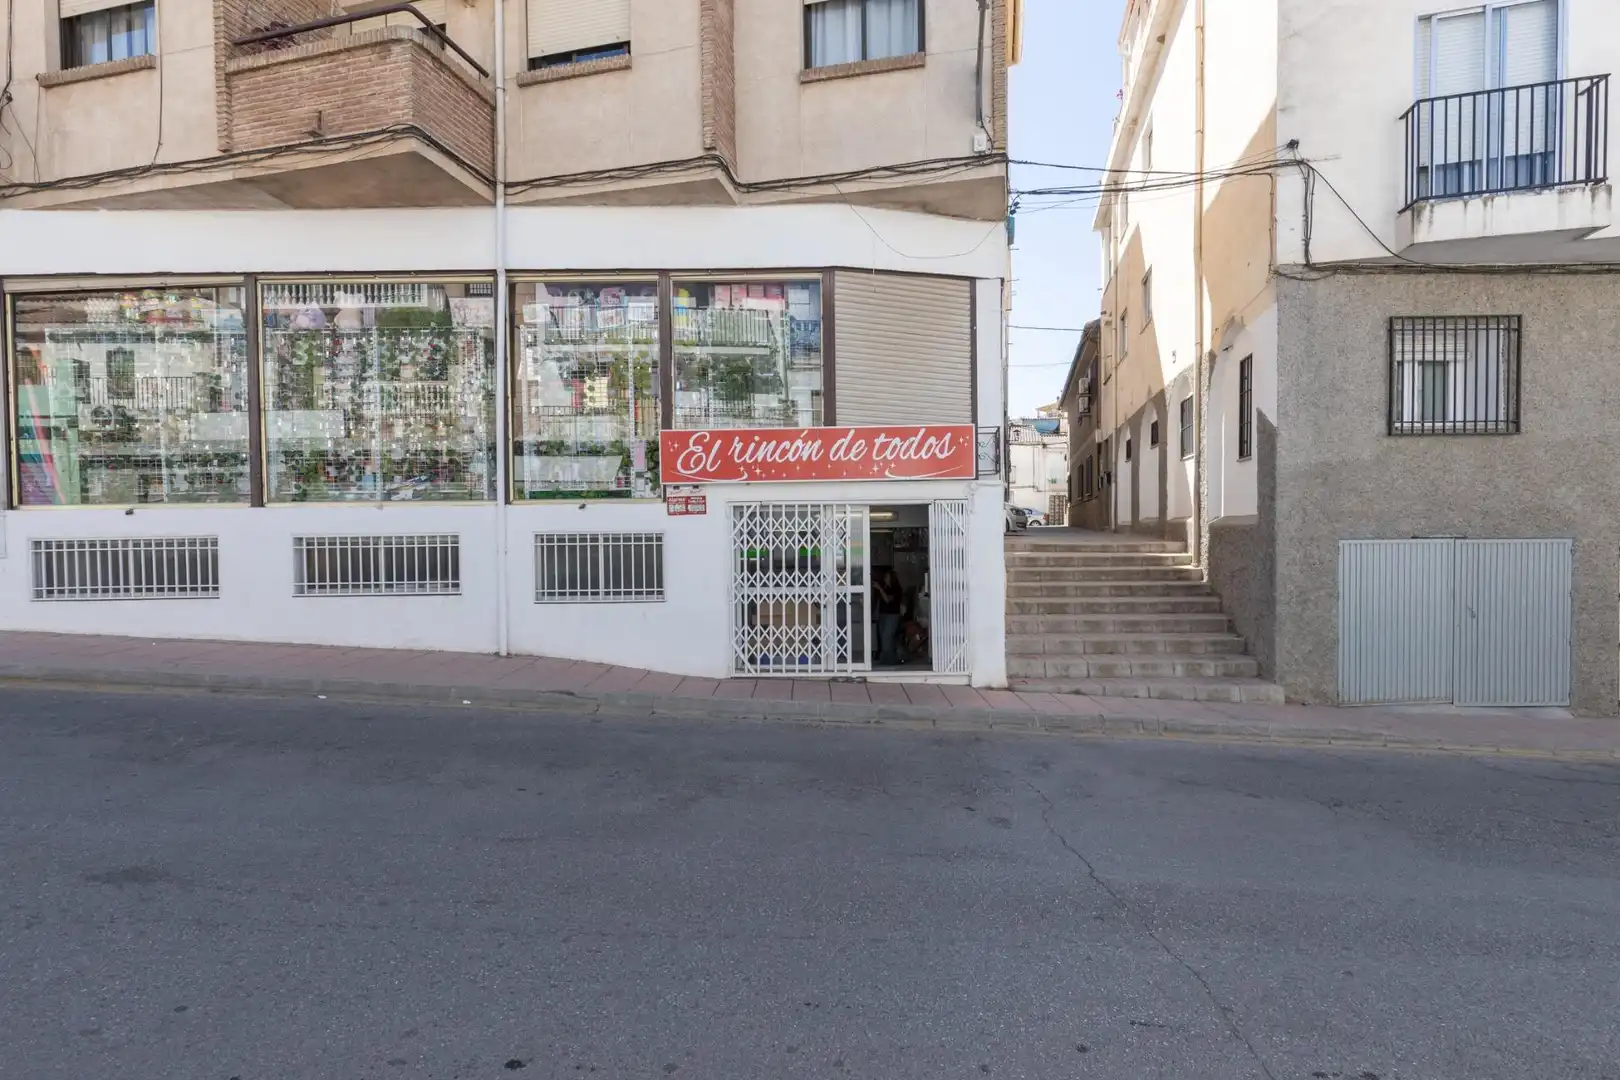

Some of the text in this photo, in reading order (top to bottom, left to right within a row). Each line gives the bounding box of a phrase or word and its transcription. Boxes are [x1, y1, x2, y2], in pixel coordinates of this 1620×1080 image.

[676, 427, 956, 474] El rincón de todos
